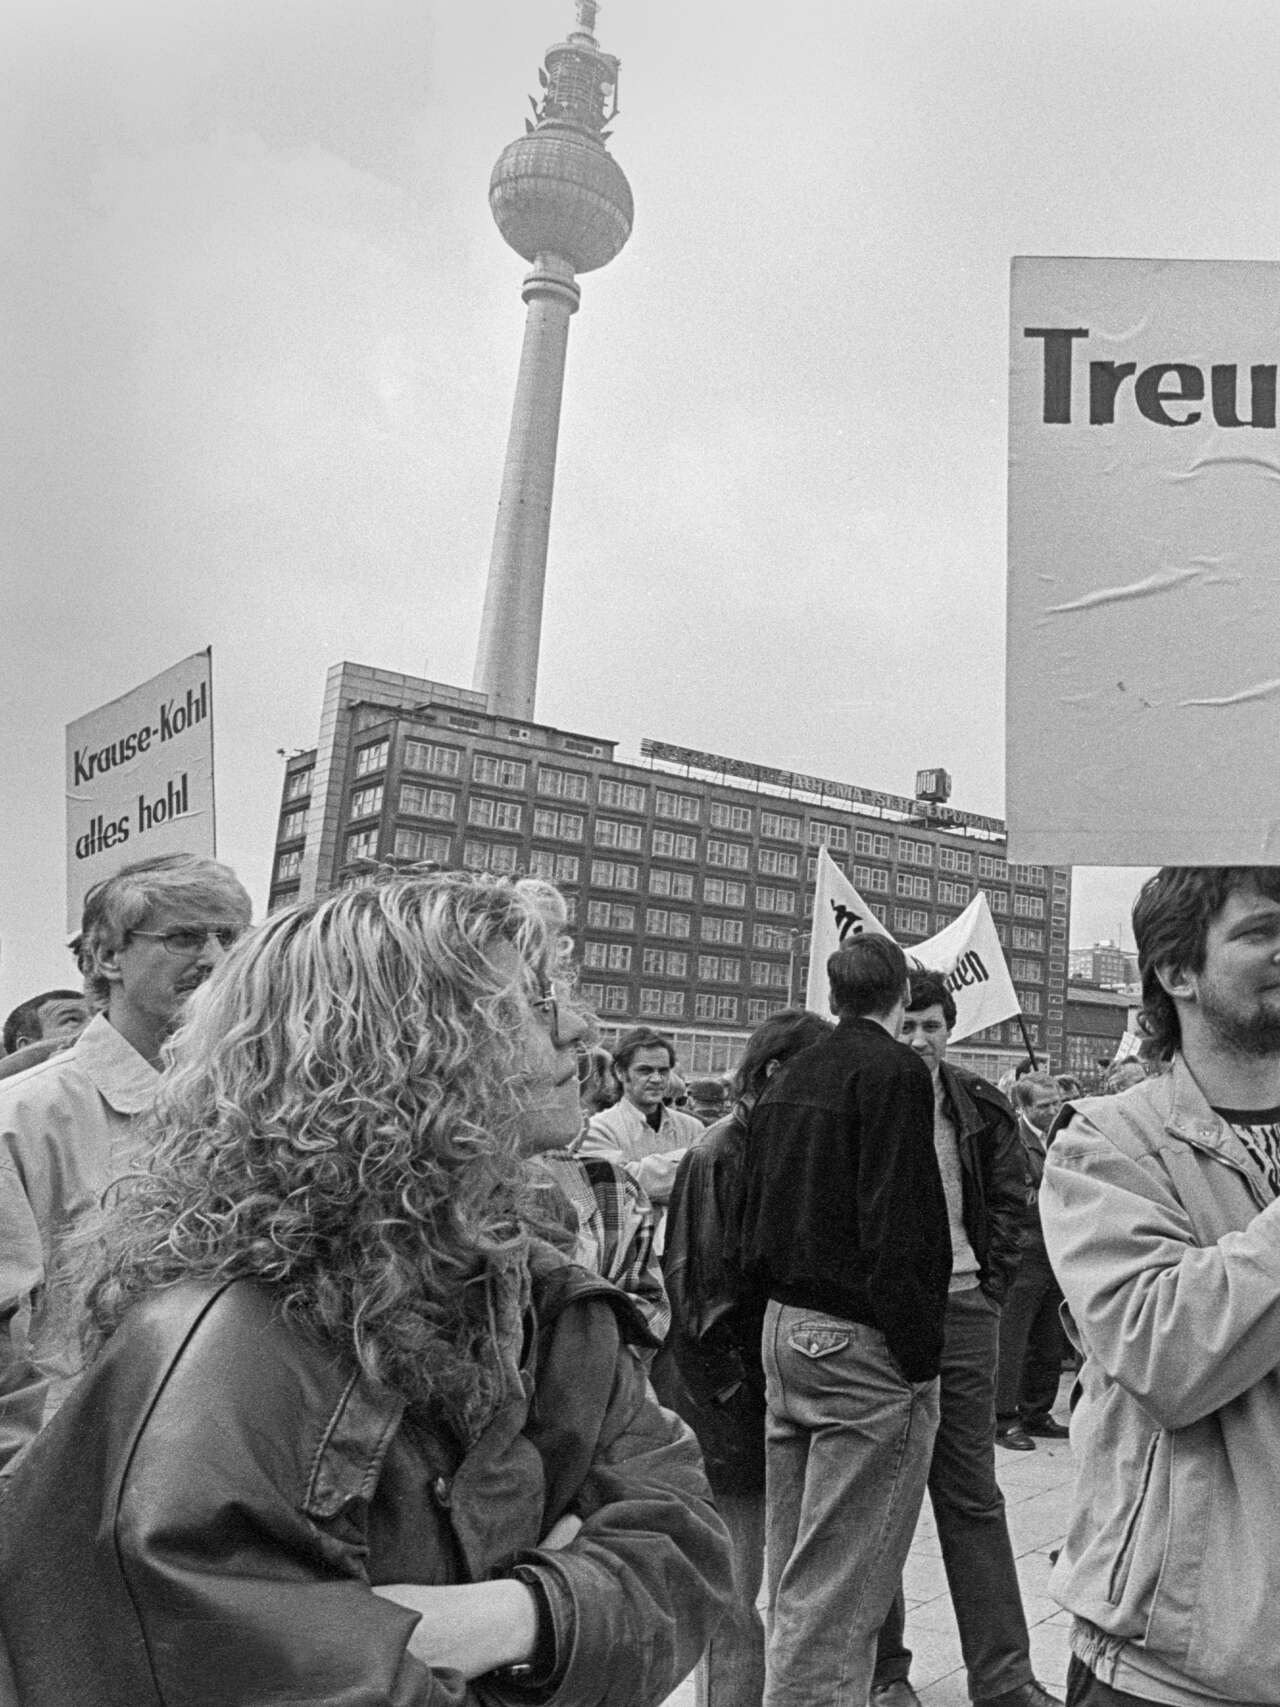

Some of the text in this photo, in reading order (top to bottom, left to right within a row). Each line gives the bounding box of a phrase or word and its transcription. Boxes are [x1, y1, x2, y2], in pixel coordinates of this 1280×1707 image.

[74, 681, 207, 786] Krause-Kohl
[75, 772, 188, 859] alles hohl
